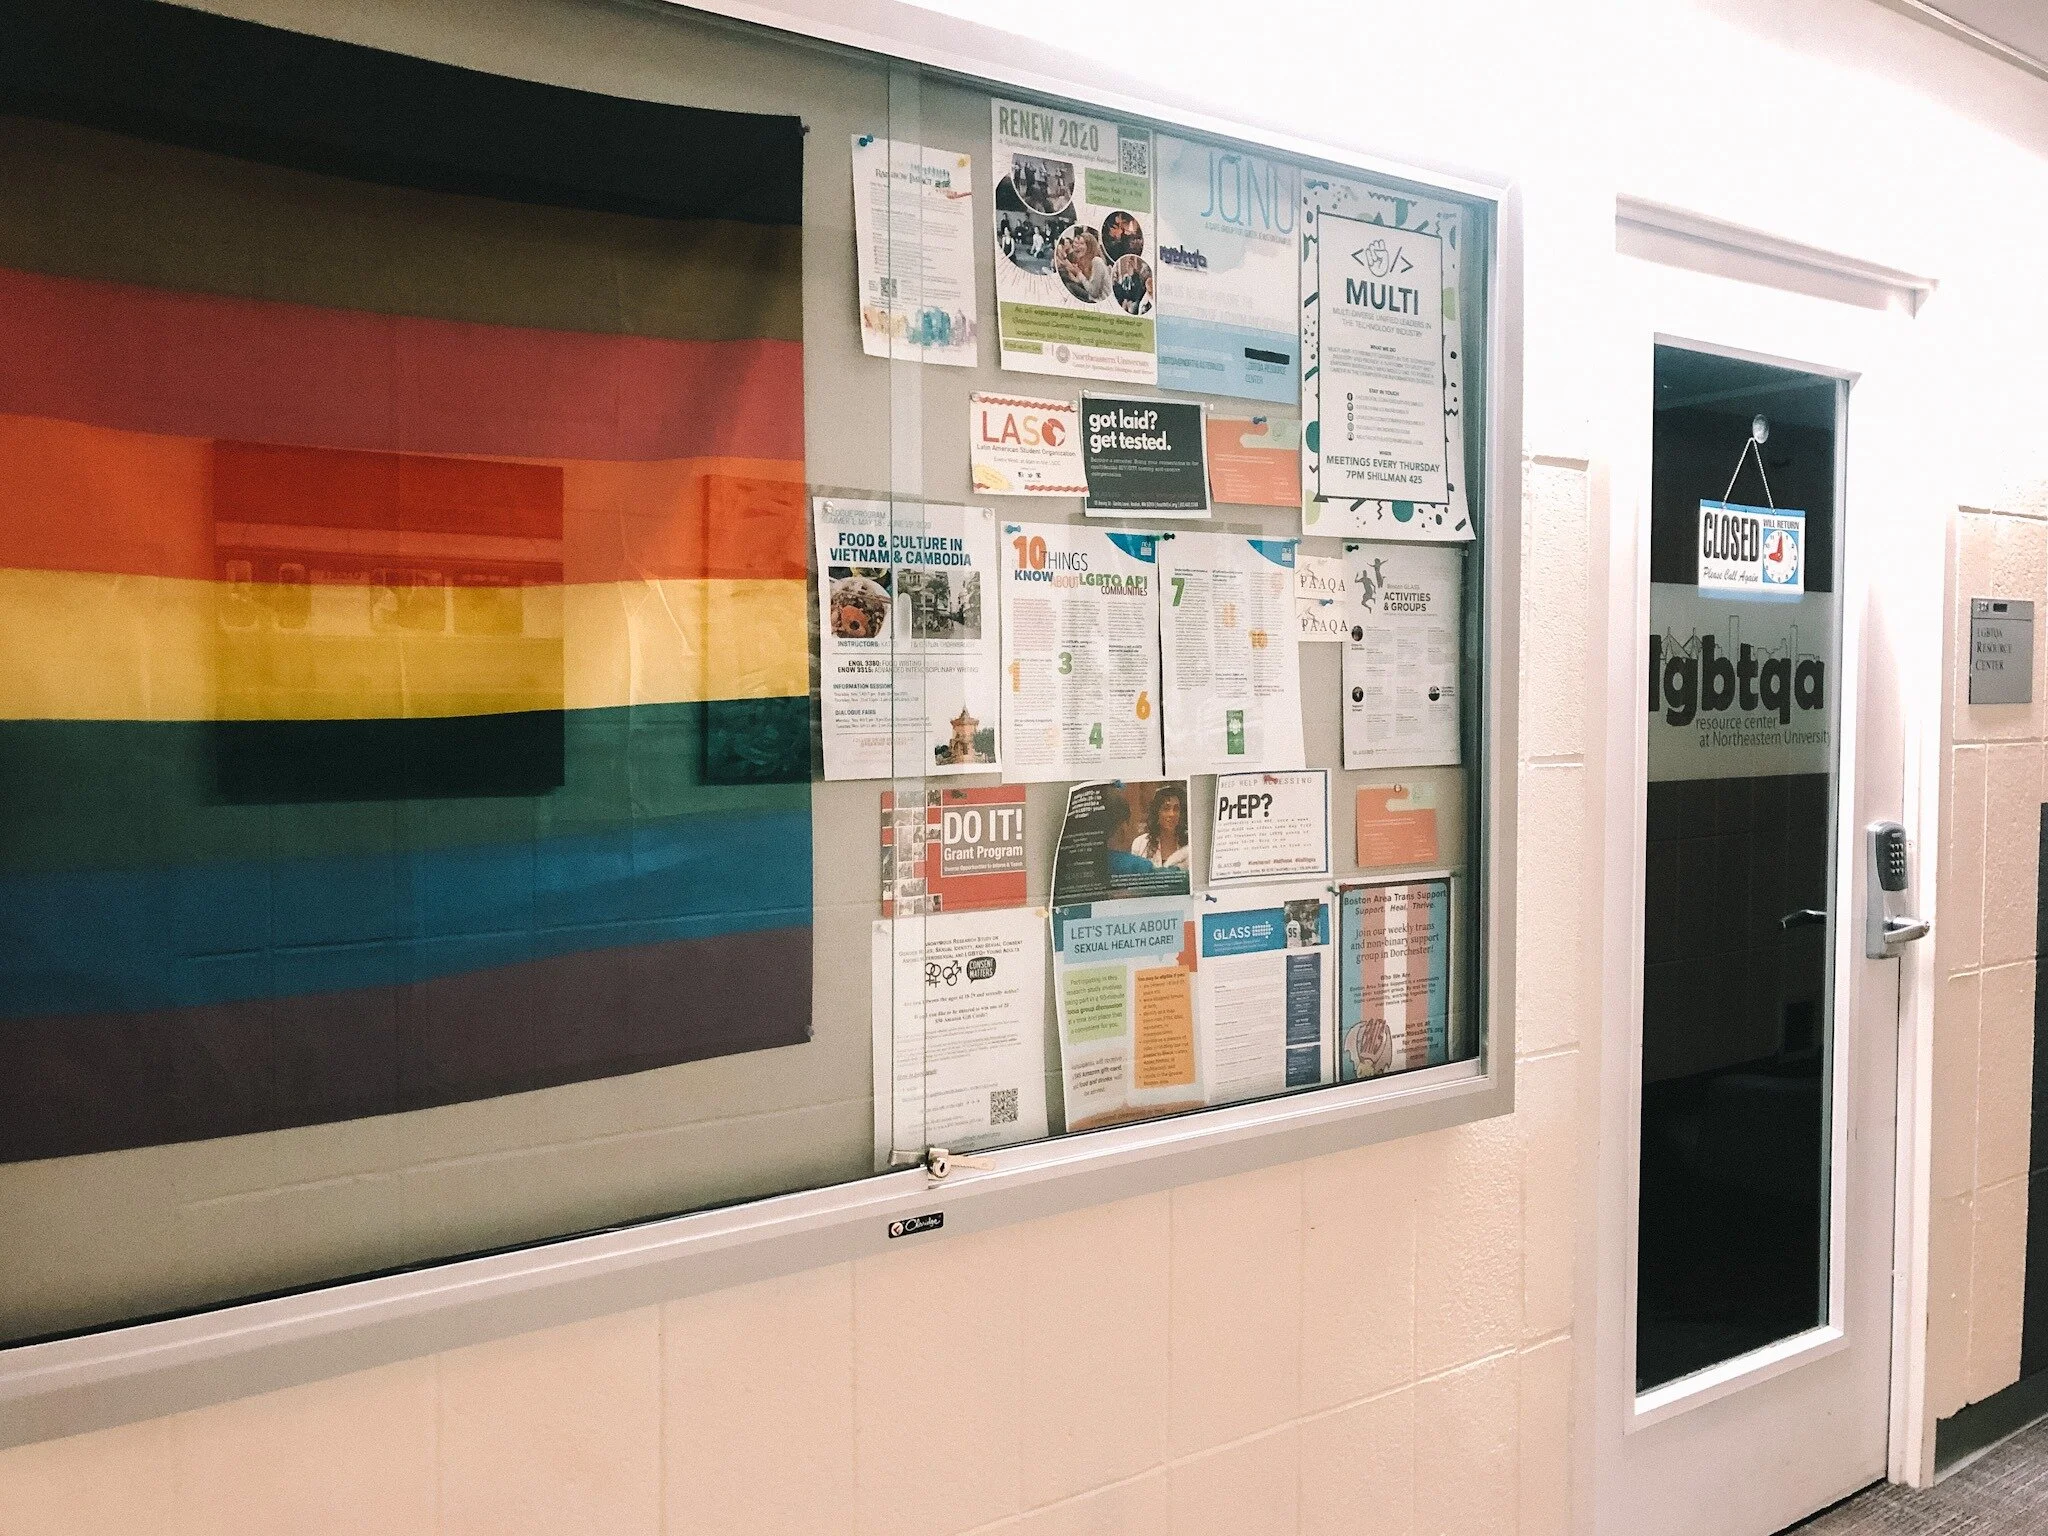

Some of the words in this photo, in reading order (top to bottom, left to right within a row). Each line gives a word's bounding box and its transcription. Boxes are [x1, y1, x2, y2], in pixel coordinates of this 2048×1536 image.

[1000, 106, 1054, 142] RENEW
[1059, 119, 1099, 151] 2020
[1346, 278, 1419, 315] MULTI
[1072, 352, 1115, 364] Northeastern
[982, 411, 1066, 446] LASO
[1089, 411, 1117, 432] got
[1119, 408, 1158, 430] laid?
[1090, 431, 1117, 453] get
[1119, 431, 1171, 450] tested.
[1326, 456, 1371, 467] MEETINGS
[1373, 459, 1397, 469] EVERY
[1400, 461, 1440, 472] THURSDAY
[1346, 470, 1365, 479] 7PM
[1367, 472, 1406, 483] SHILLMAN
[1763, 519, 1776, 528] WILL
[1777, 520, 1799, 530] RETURN
[839, 533, 874, 547] FOOD
[878, 535, 887, 547] &
[892, 536, 947, 549] CULTURE
[950, 539, 962, 550] IN
[1704, 512, 1759, 562] CLOSED
[830, 548, 889, 562] VIETNAM
[893, 551, 902, 563] &
[905, 551, 971, 566] CAMBODIA
[1013, 536, 1047, 570] 10
[1042, 551, 1088, 571] THINGS
[1015, 570, 1053, 581] KNOW
[1052, 575, 1079, 588] ABOUT
[1079, 573, 1122, 586] LGBTQ
[1126, 576, 1147, 587] API
[1301, 574, 1346, 593] PAAQA
[1703, 566, 1722, 580] Please
[1724, 569, 1738, 581] Call
[1740, 571, 1758, 584] Again
[1101, 586, 1147, 596] COMMUNITIES
[1171, 578, 1185, 606] 7
[1384, 592, 1431, 602] ACTIVITIES
[1391, 603, 1426, 612] GROUPS
[1302, 618, 1348, 634] PAAQA
[1977, 642, 2012, 653] RESOURCE
[1058, 652, 1072, 674] 3
[1976, 660, 2004, 671] CENTER
[1649, 634, 1824, 726] lgbtqa
[1136, 691, 1150, 720] 6
[1696, 716, 1741, 730] resource
[1744, 716, 1778, 729] center
[1089, 722, 1103, 749] 4
[1700, 733, 1710, 747] at
[1713, 731, 1781, 747] Northeastern
[1219, 793, 1273, 820] PrEP?
[944, 810, 982, 845] DO
[989, 809, 1022, 842] IT!
[944, 847, 974, 861] Grant
[977, 845, 1023, 860] Program
[1344, 896, 1371, 906] Boston
[1374, 895, 1391, 904] Area
[1394, 892, 1414, 901] Trans
[1417, 890, 1446, 900] Support
[1071, 926, 1102, 940] LET'S
[1106, 922, 1136, 936] TALK
[1139, 919, 1177, 932] ABOUT
[1214, 926, 1251, 941] GLASS
[1355, 930, 1371, 940] Join
[1388, 924, 1413, 934] weekly
[1415, 922, 1434, 931] trans
[1074, 942, 1108, 954] SEXUAL
[1112, 938, 1146, 949] HEALTH
[1149, 935, 1174, 946] CARE!
[1351, 941, 1365, 950] and
[1367, 936, 1408, 949] non-binary
[1411, 934, 1439, 944] support
[1356, 951, 1379, 964] group
[1390, 945, 1433, 957] Dorchester!
[969, 960, 994, 969] CONSENT
[969, 968, 993, 978] MATTERS
[1082, 1069, 1100, 1077] Amazon
